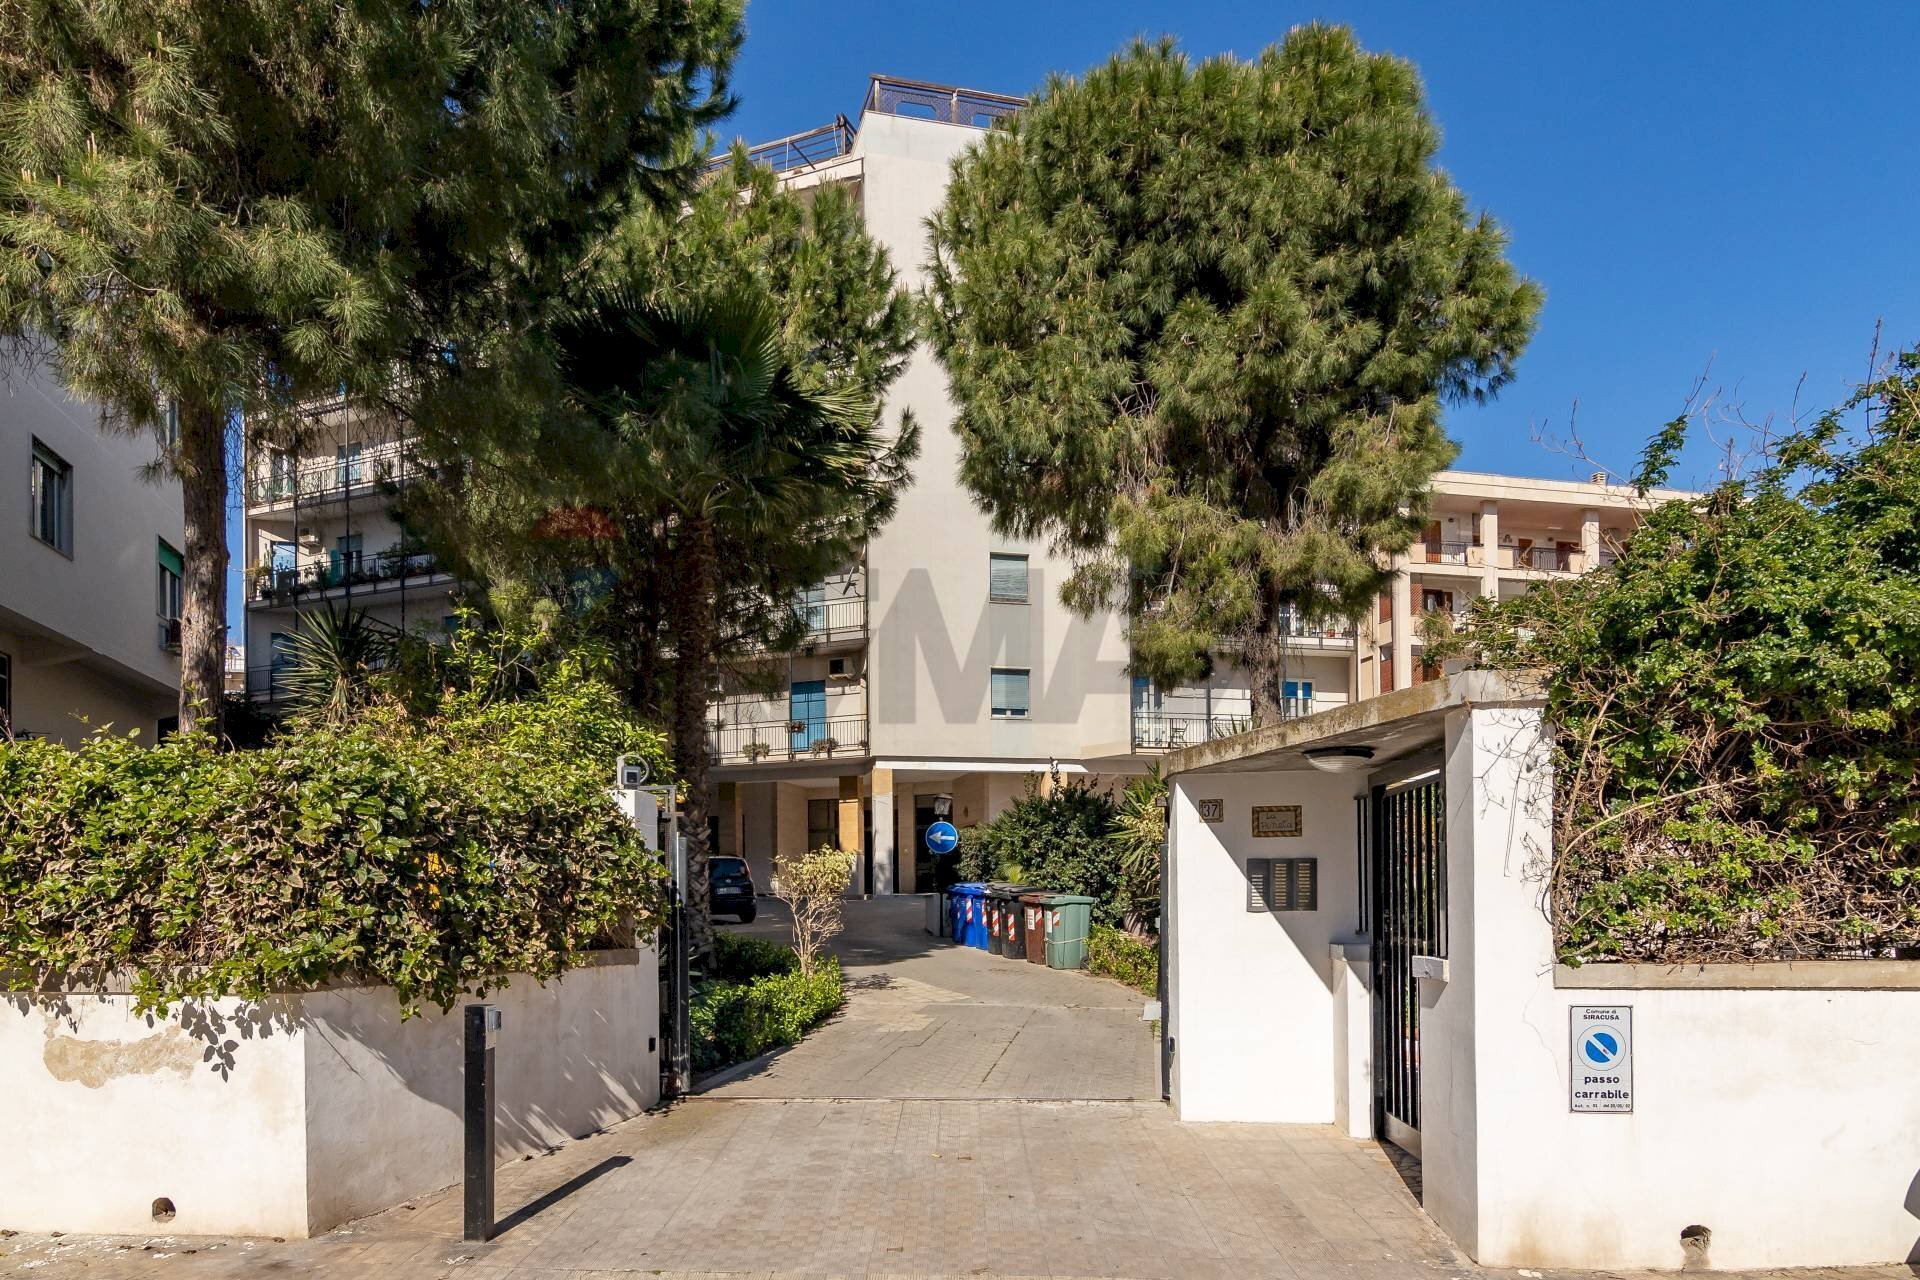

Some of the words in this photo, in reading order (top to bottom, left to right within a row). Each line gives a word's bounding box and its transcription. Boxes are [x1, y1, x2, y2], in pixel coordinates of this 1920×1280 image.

[1203, 804, 1218, 817] 37
[1584, 1076, 1620, 1085] passo
[1574, 1090, 1630, 1099] carrabile
